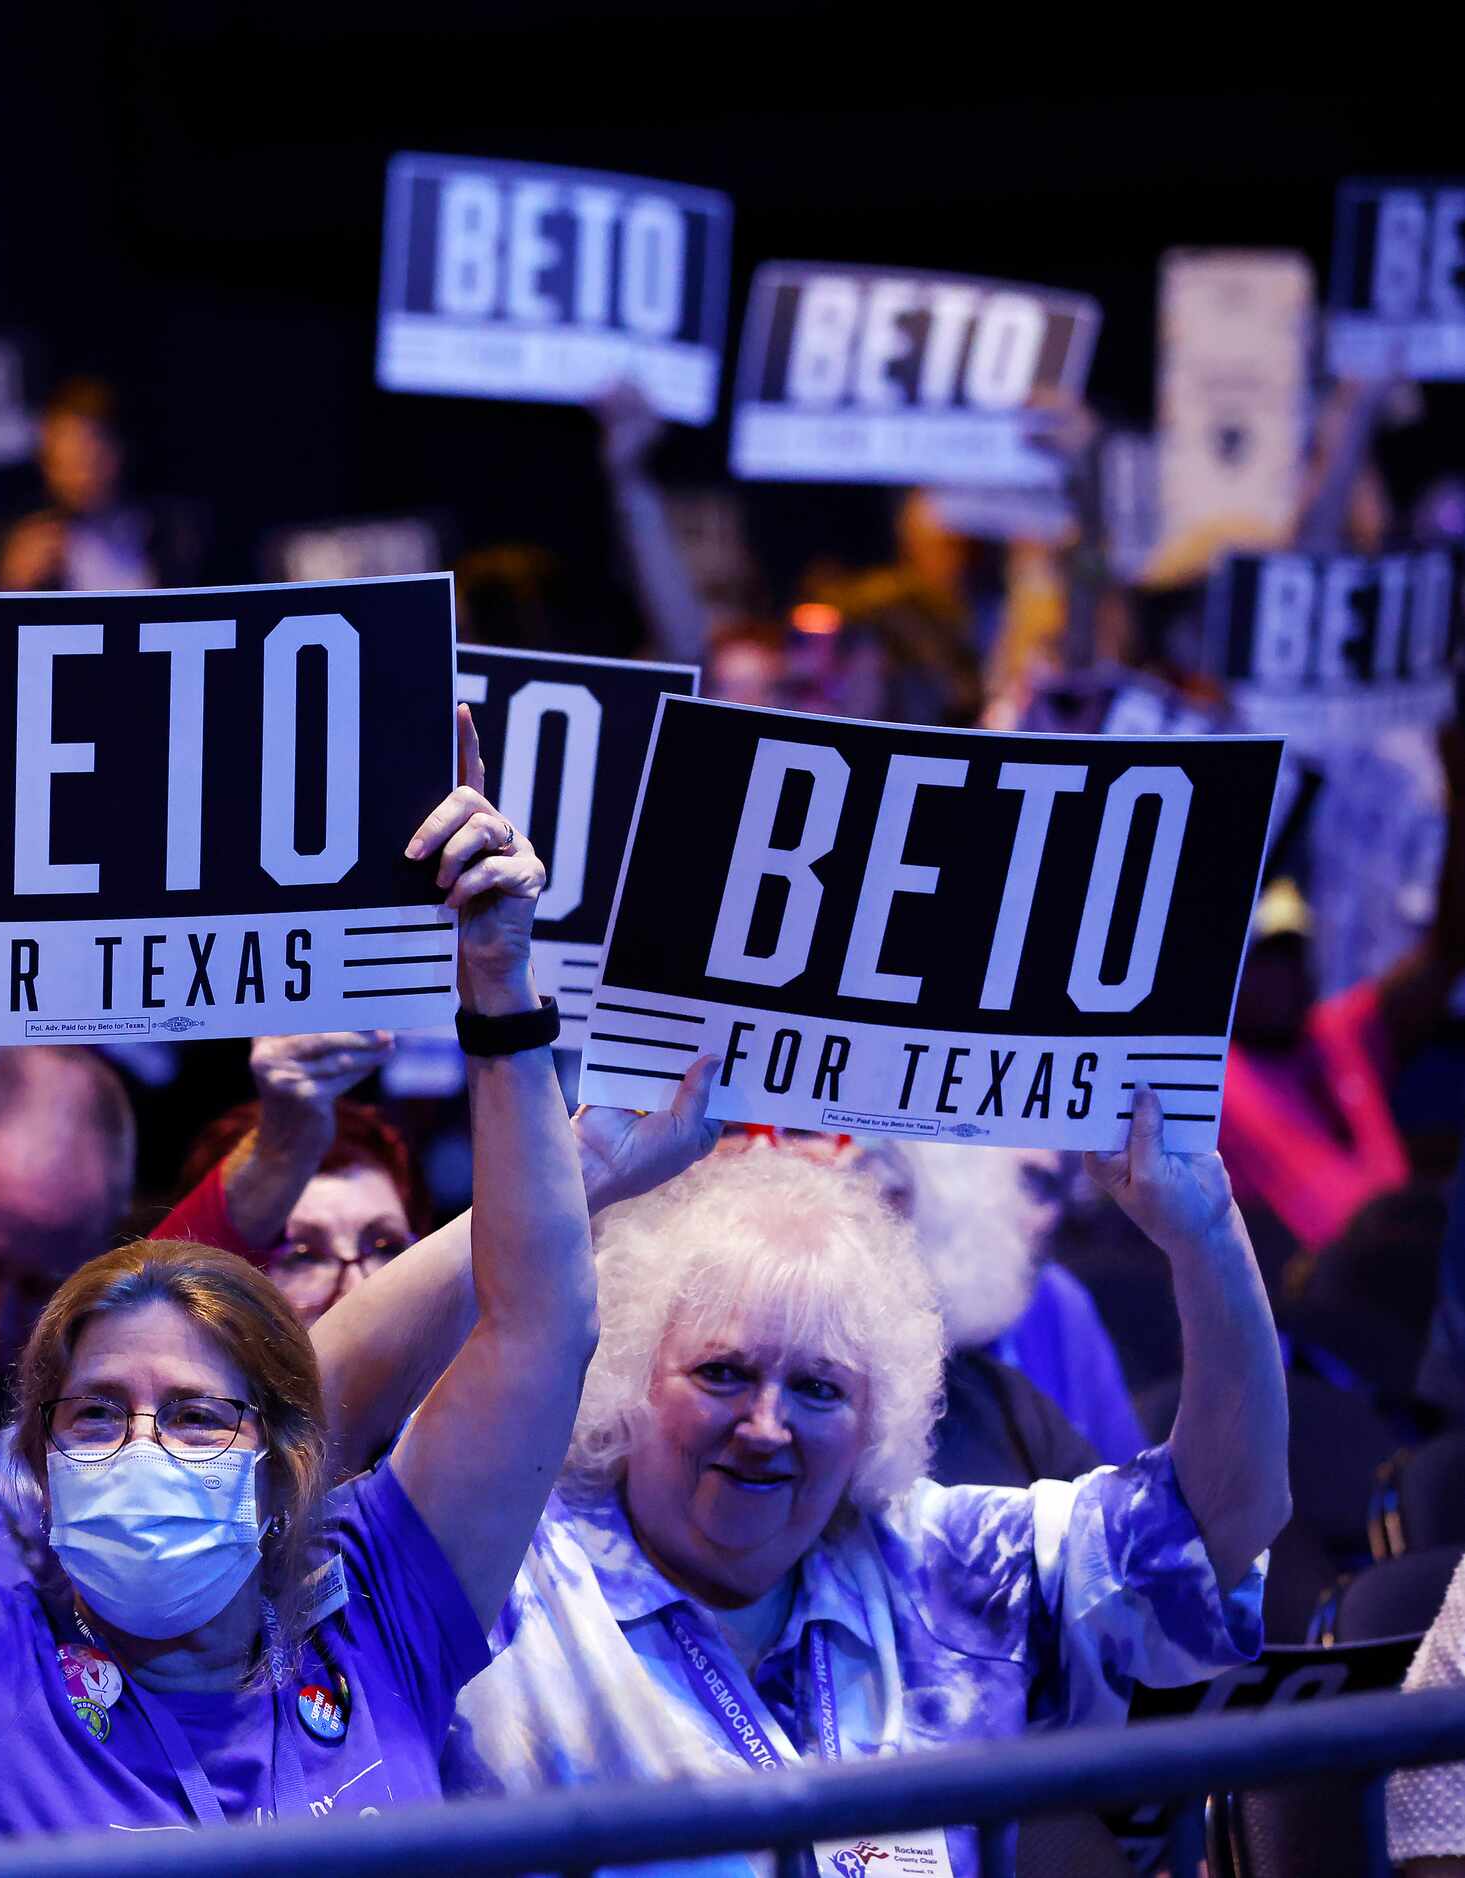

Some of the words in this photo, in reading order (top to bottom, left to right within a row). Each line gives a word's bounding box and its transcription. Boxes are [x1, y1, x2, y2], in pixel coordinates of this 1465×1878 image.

[441, 174, 685, 336] BETO
[790, 275, 1046, 409] BETO
[457, 672, 603, 921] O
[705, 737, 1194, 1013] BETO
[94, 928, 313, 1010] TEXAS
[30, 1024, 44, 1032] Pol.
[45, 1024, 60, 1032] Adv.
[61, 1023, 77, 1031] Paid
[77, 1023, 86, 1031] for
[88, 1024, 97, 1032] by
[114, 1022, 124, 1030] for
[721, 1021, 852, 1103] FOR
[898, 1043, 1100, 1120] TEXAS
[311, 1690, 325, 1721] SUPPORT
[322, 1702, 333, 1721] BEER
[703, 1668, 778, 1773] DEMOCRATIC
[894, 1846, 934, 1856] Rockwall
[894, 1855, 918, 1864] County
